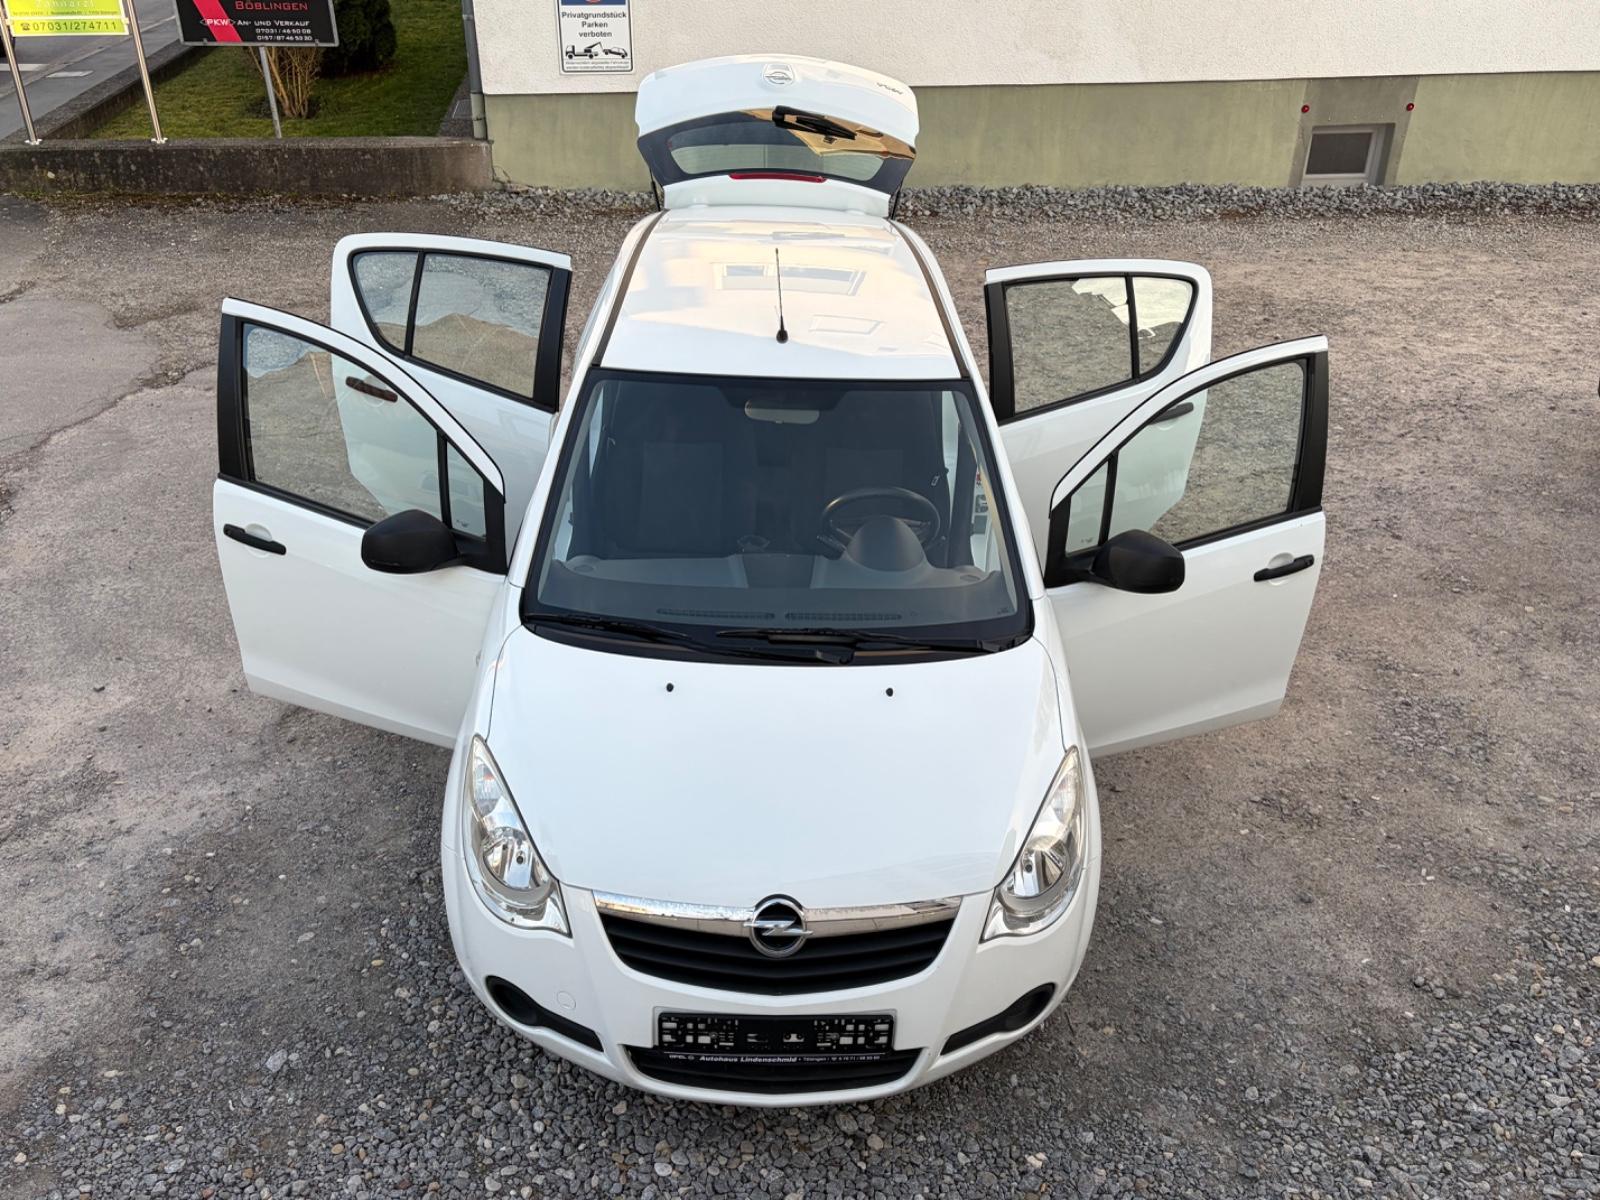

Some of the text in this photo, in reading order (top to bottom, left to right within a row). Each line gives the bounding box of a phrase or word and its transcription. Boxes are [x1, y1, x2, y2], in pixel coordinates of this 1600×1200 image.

[561, 11, 627, 20] Privatgrundstück
[32, 21, 117, 31] 07031/274711
[578, 30, 612, 38] verboten
[740, 1055, 797, 1063] Lindenschmid
